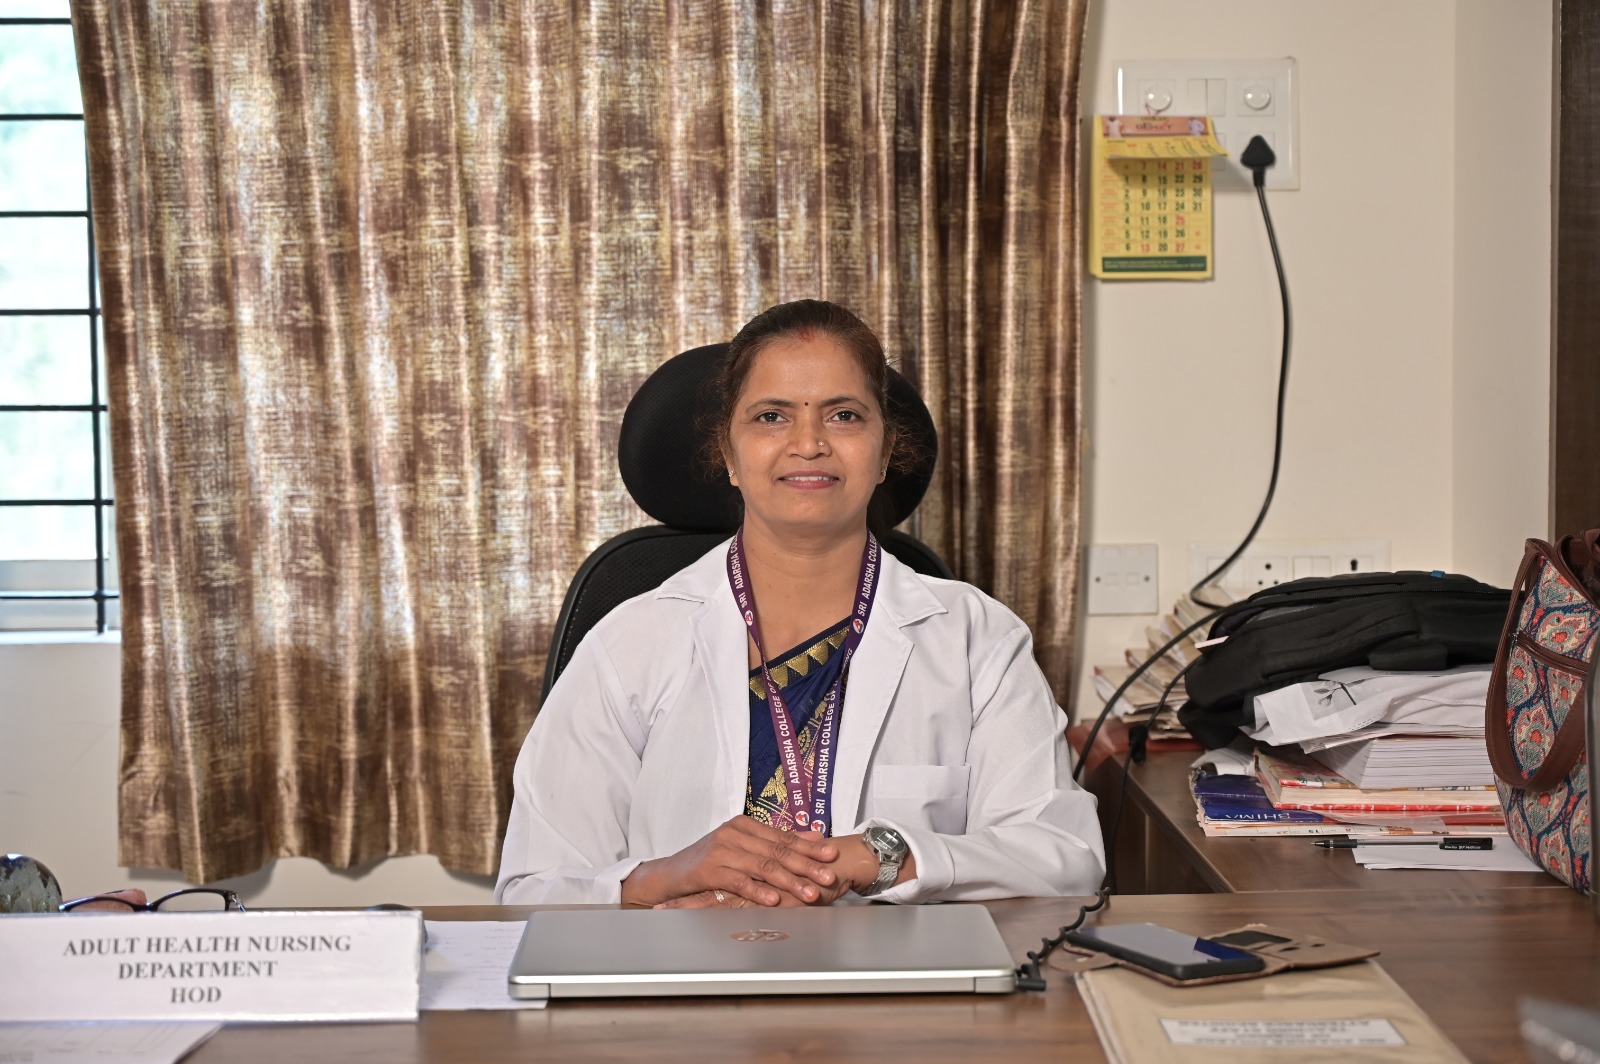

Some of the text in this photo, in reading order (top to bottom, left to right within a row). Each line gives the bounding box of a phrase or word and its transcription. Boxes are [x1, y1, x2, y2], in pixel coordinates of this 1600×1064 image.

[1141, 202, 1150, 211] 10
[731, 553, 744, 589] ADARSHA
[862, 563, 875, 599] ADARSHA
[739, 592, 747, 608] SRI
[858, 602, 867, 616] SRI
[768, 682, 776, 693] OF
[773, 695, 790, 736] COLLEGE
[821, 702, 834, 745] COLLEGE
[782, 739, 800, 784] ADARSHA
[817, 749, 829, 793] ADARSHA
[795, 789, 804, 806] SRI
[815, 798, 825, 815] SRI
[64, 935, 352, 957] ADULT HEALTH NURSING
[119, 961, 278, 980] DEPARTMENT
[170, 986, 222, 1004] HOD
